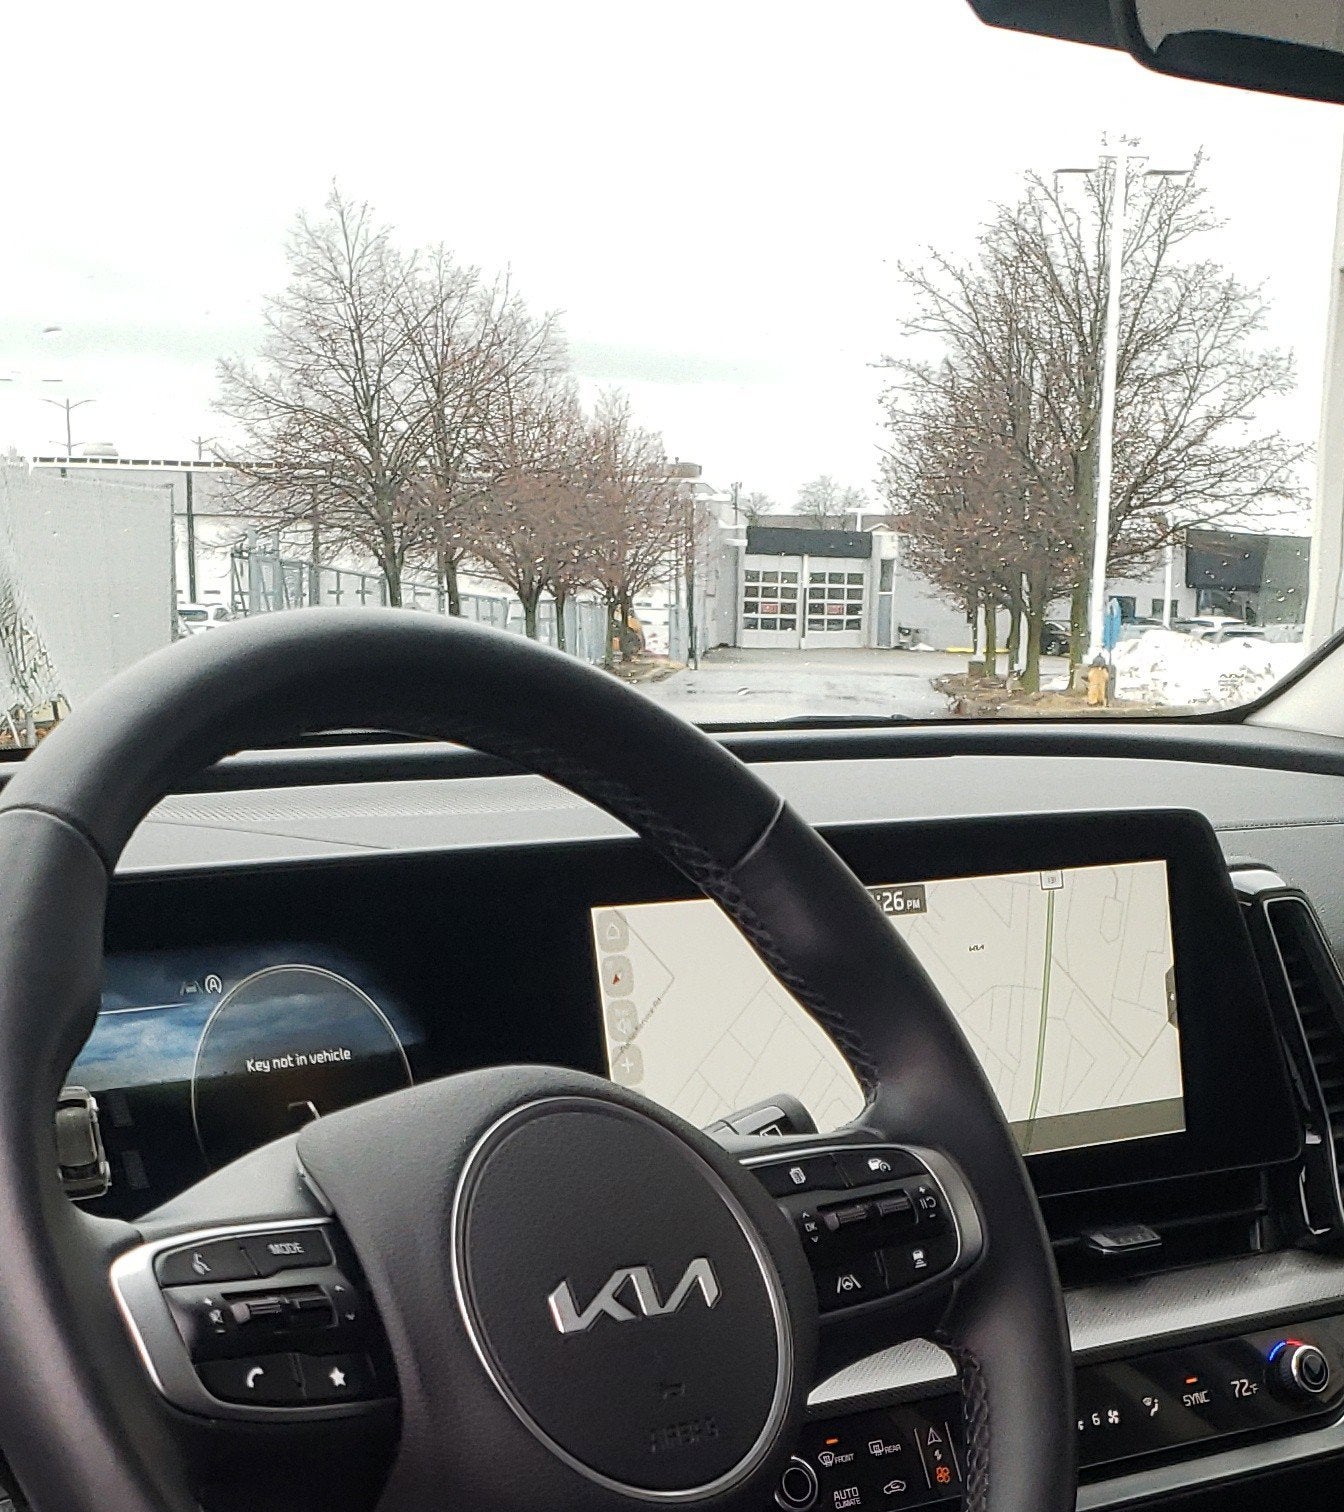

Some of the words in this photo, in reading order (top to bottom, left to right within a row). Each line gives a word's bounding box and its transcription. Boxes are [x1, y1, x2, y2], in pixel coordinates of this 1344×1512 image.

[906, 899, 921, 910] PM
[246, 1059, 271, 1074] Key
[272, 1054, 294, 1070] not
[296, 1053, 308, 1066] in
[309, 1047, 352, 1065] vehicle
[267, 1243, 305, 1255] MODE
[548, 1257, 723, 1334] KIA
[1183, 1390, 1210, 1407] SYNC
[884, 1444, 902, 1454] REAR
[834, 1453, 855, 1464] FRONT
[834, 1486, 859, 1501] AUTO
[835, 1498, 862, 1509] CLIMATE
